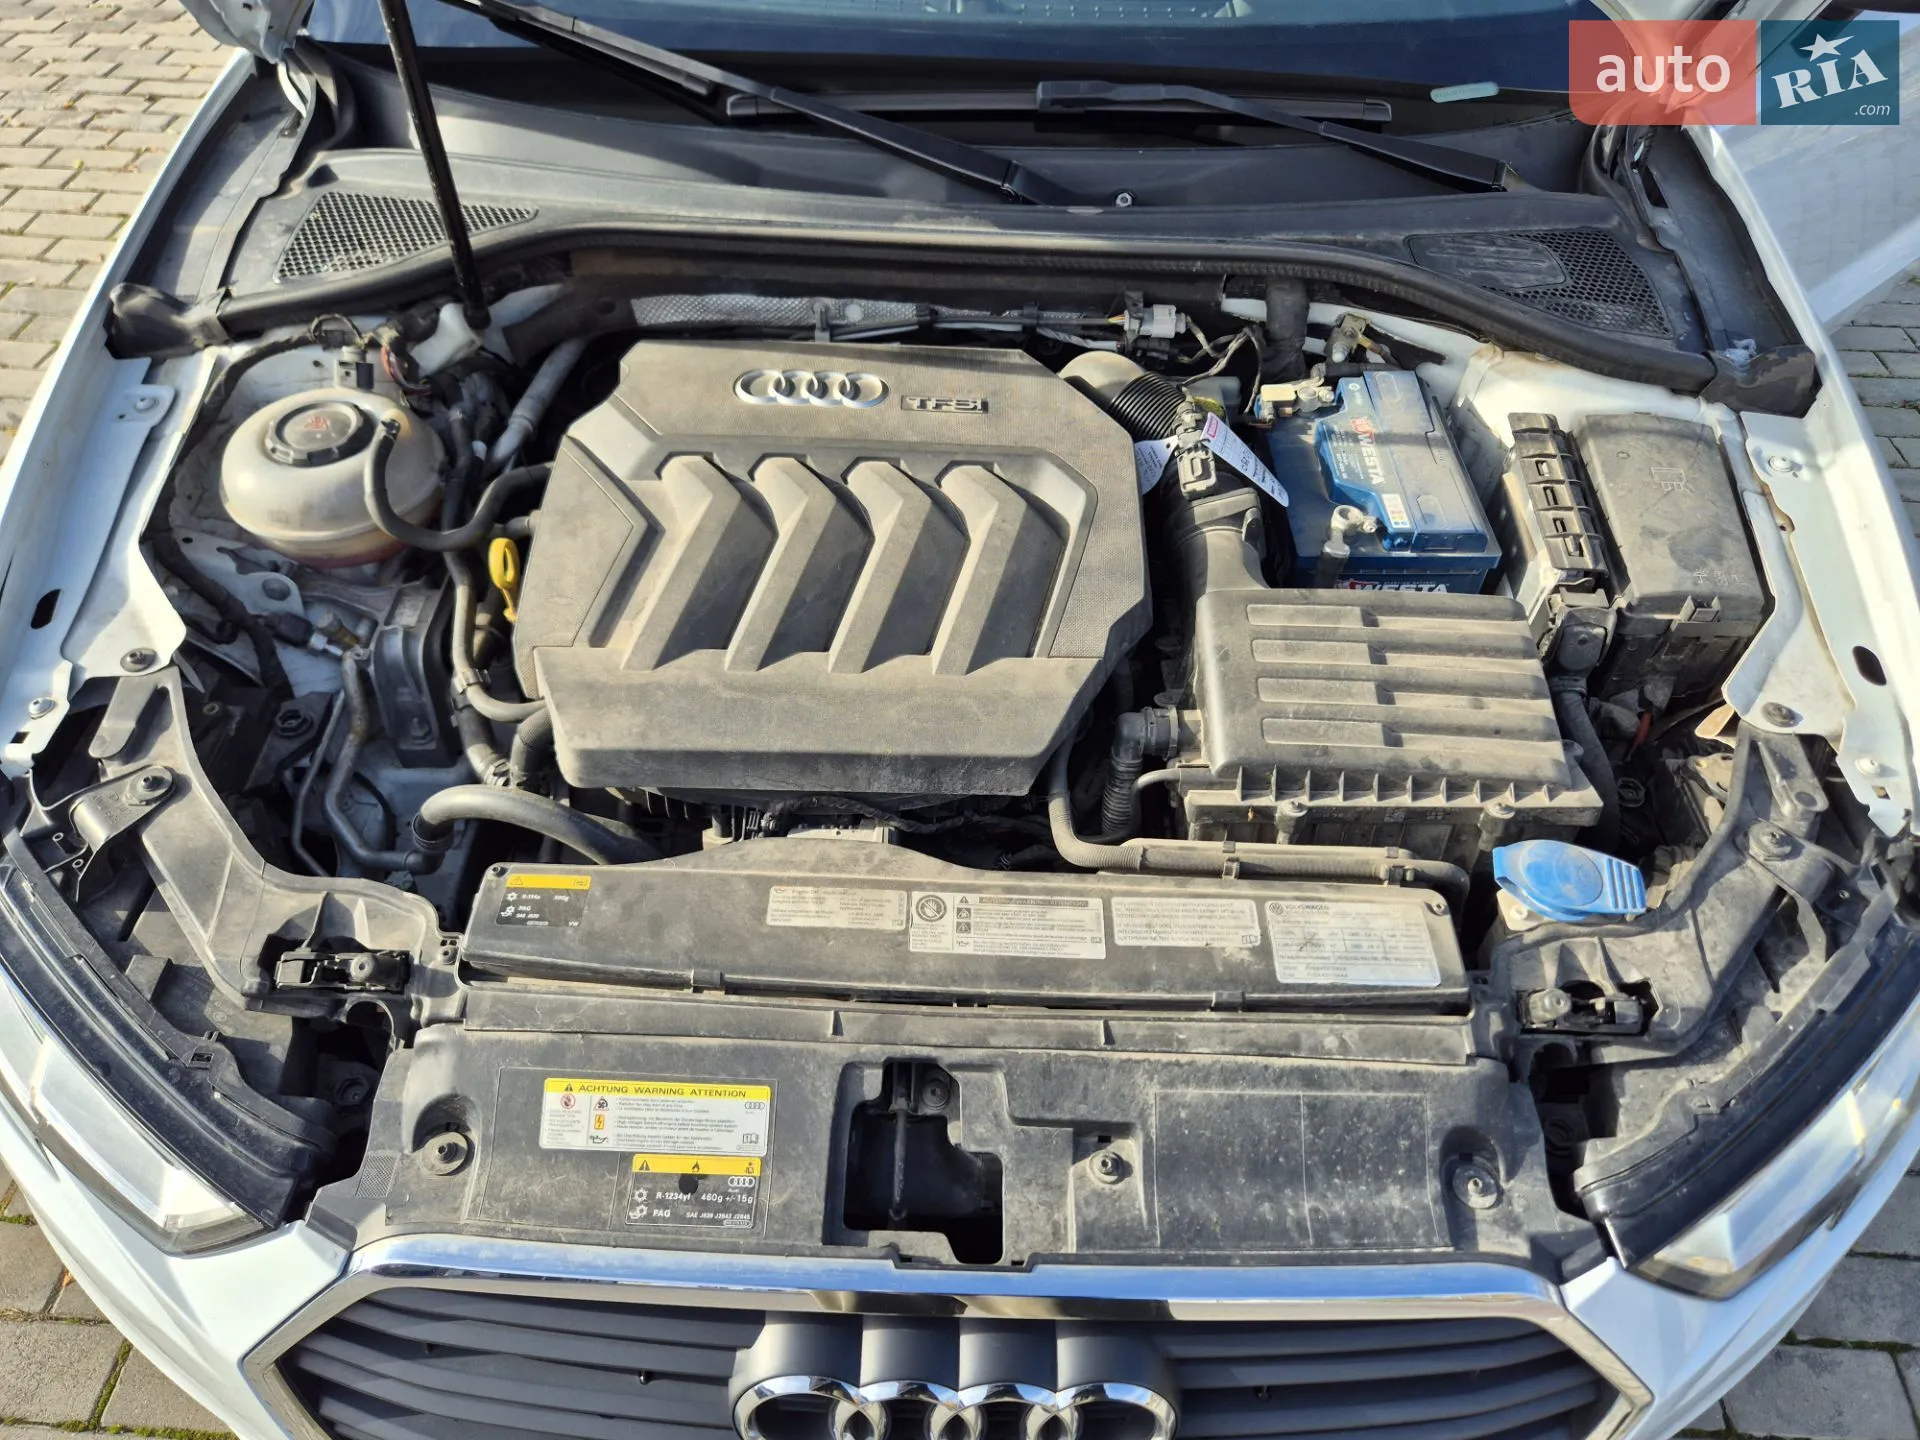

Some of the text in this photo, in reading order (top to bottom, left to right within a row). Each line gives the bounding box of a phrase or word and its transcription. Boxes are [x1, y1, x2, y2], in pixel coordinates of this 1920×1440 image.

[904, 396, 986, 413] TFSI
[1358, 434, 1386, 485] WESTA
[578, 1084, 747, 1098] ACHTUNG WARNING ATTENTION
[656, 1192, 691, 1202] R-1234yf
[701, 1193, 723, 1203] 460g
[653, 1209, 671, 1218] PAG
[686, 1211, 698, 1219] SAE
